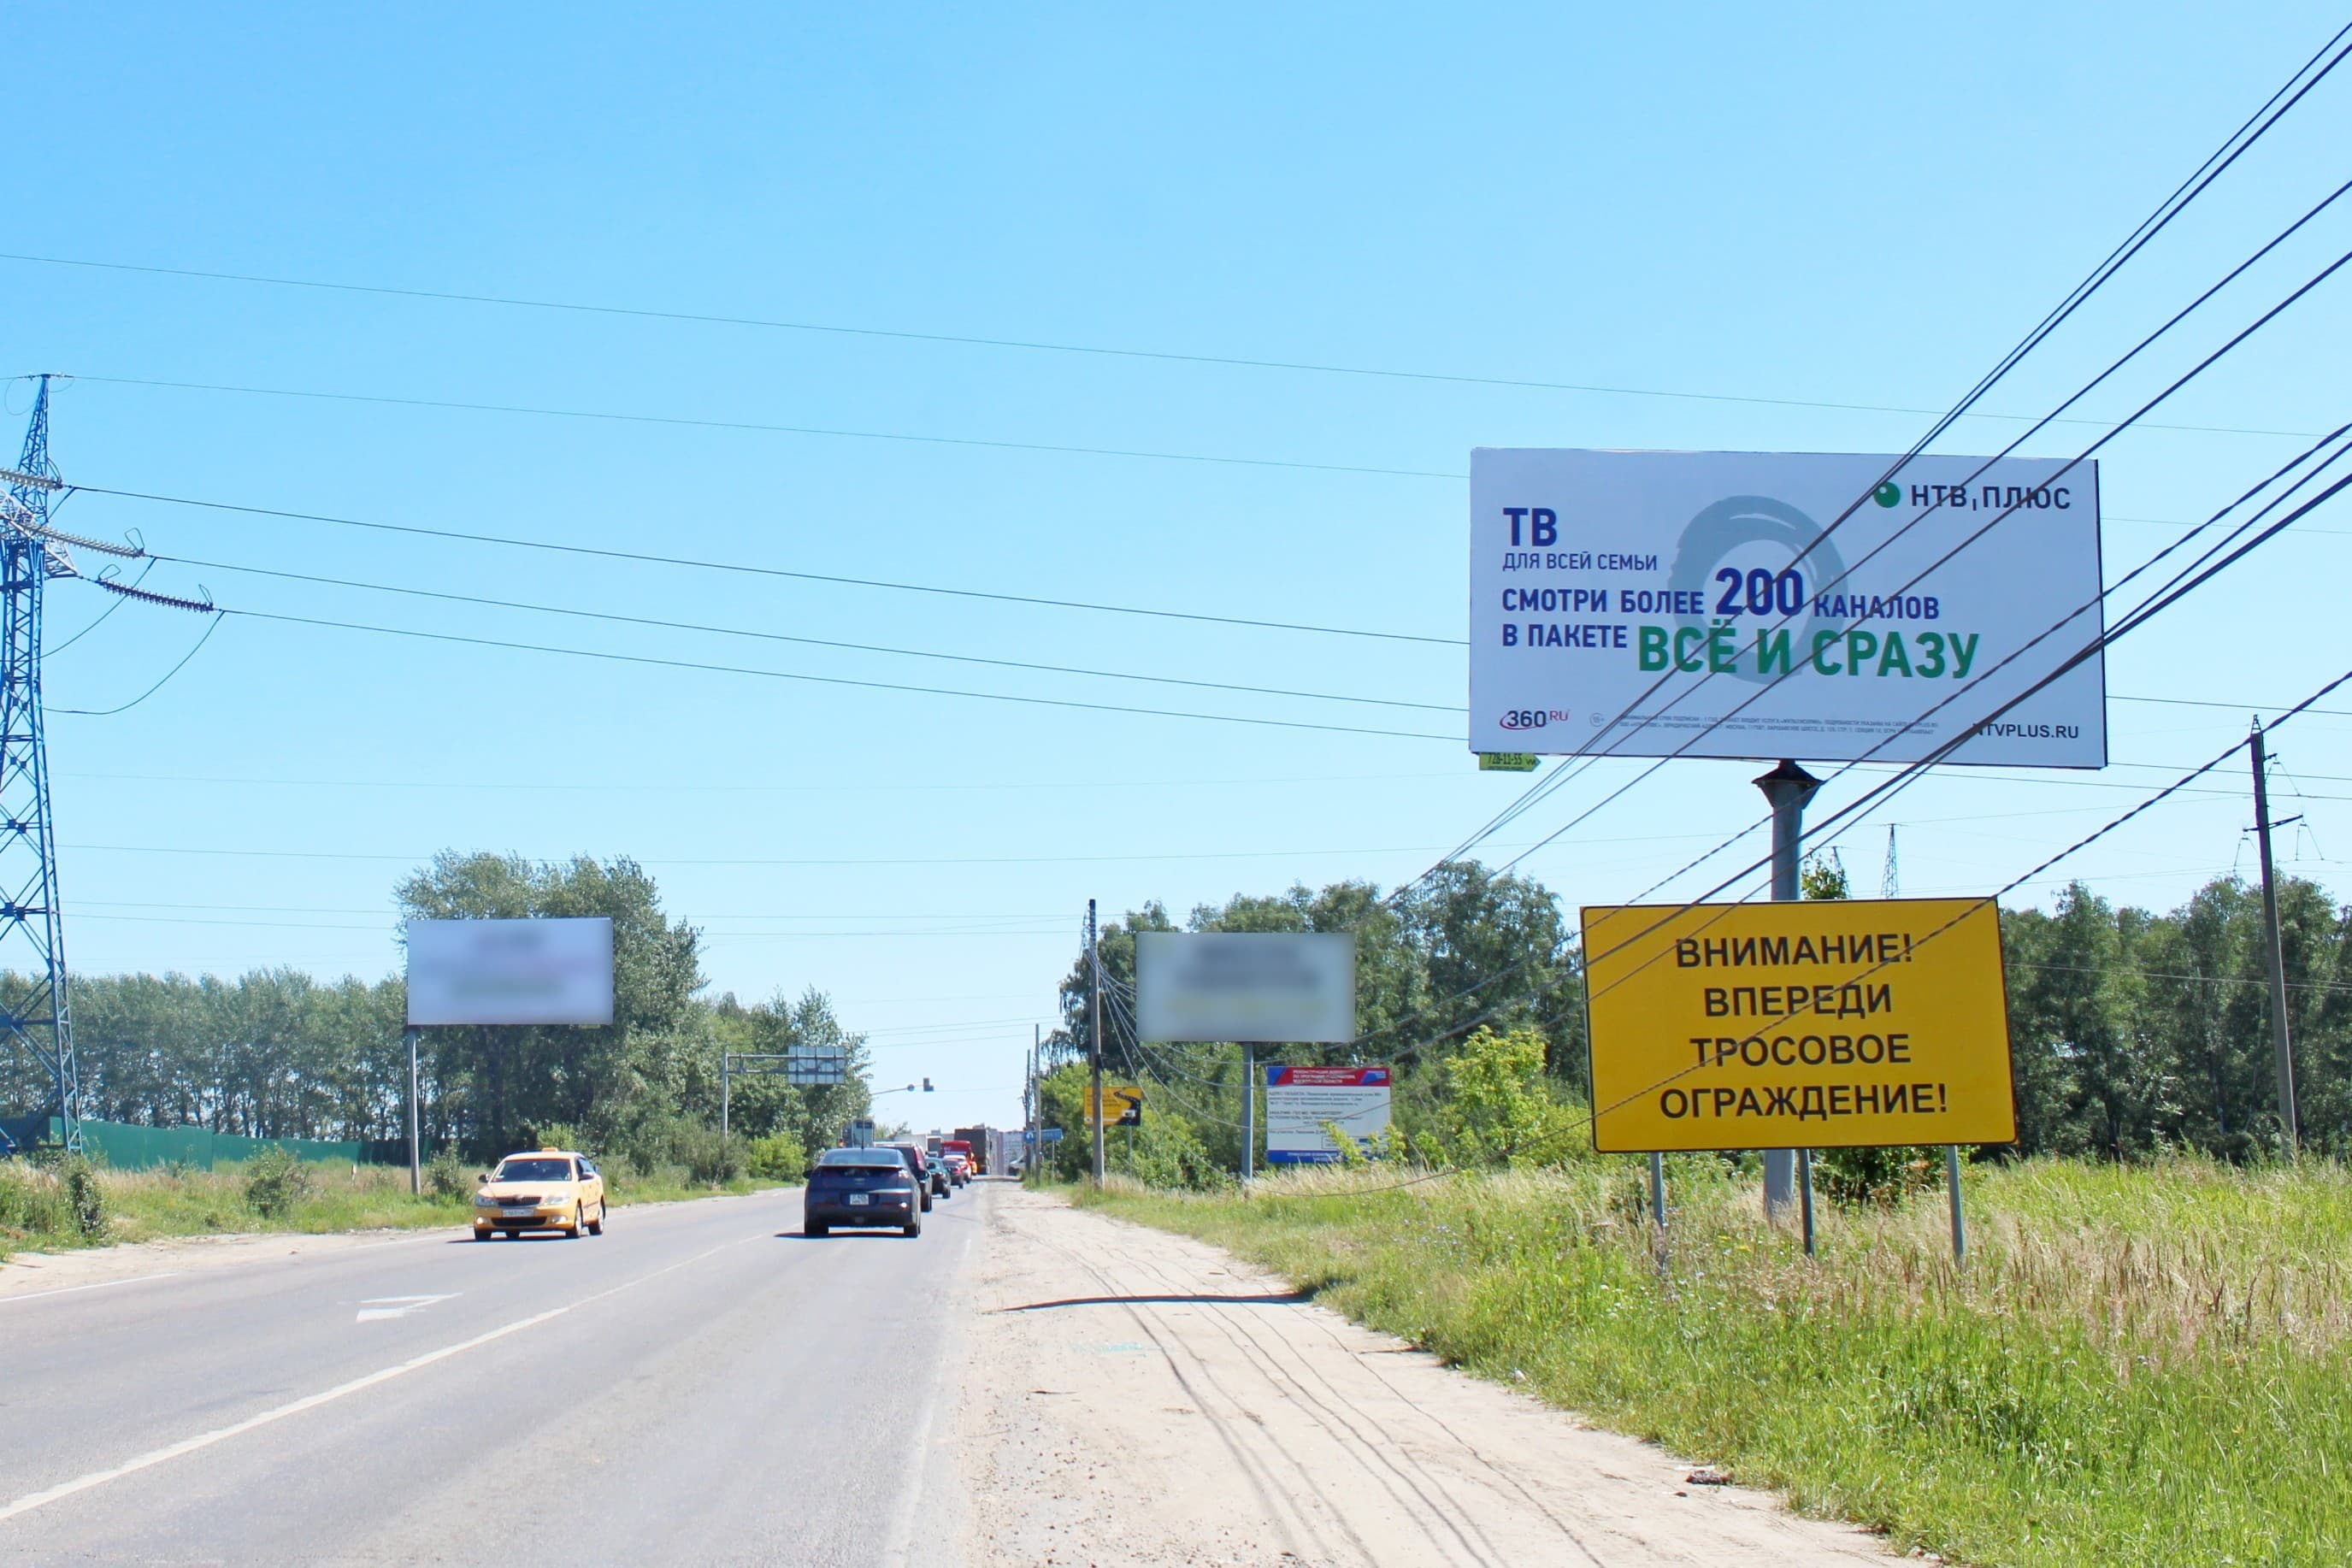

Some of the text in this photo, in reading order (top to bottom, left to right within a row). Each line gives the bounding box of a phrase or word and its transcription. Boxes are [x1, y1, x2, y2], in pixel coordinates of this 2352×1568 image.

[1503, 508, 1557, 546] ТВ
[1503, 551, 1658, 571] ДЛЯ ВСЕЙ СЕМЬИ
[1502, 567, 1940, 620] СМОТРИ БОЛЕЕ 200 КАНАЛОВ
[1502, 619, 1979, 678] В ПАКЕТЕ ВСЁ И СРАЗУ
[1676, 934, 1913, 968] ВНИМАНИЕ!
[1704, 984, 1891, 1020] ВПЕРЕДИ
[1689, 1034, 1911, 1067] ТРОСОВОЕ
[1660, 1083, 1947, 1122] ОГРАЖДЕНИЕ!
